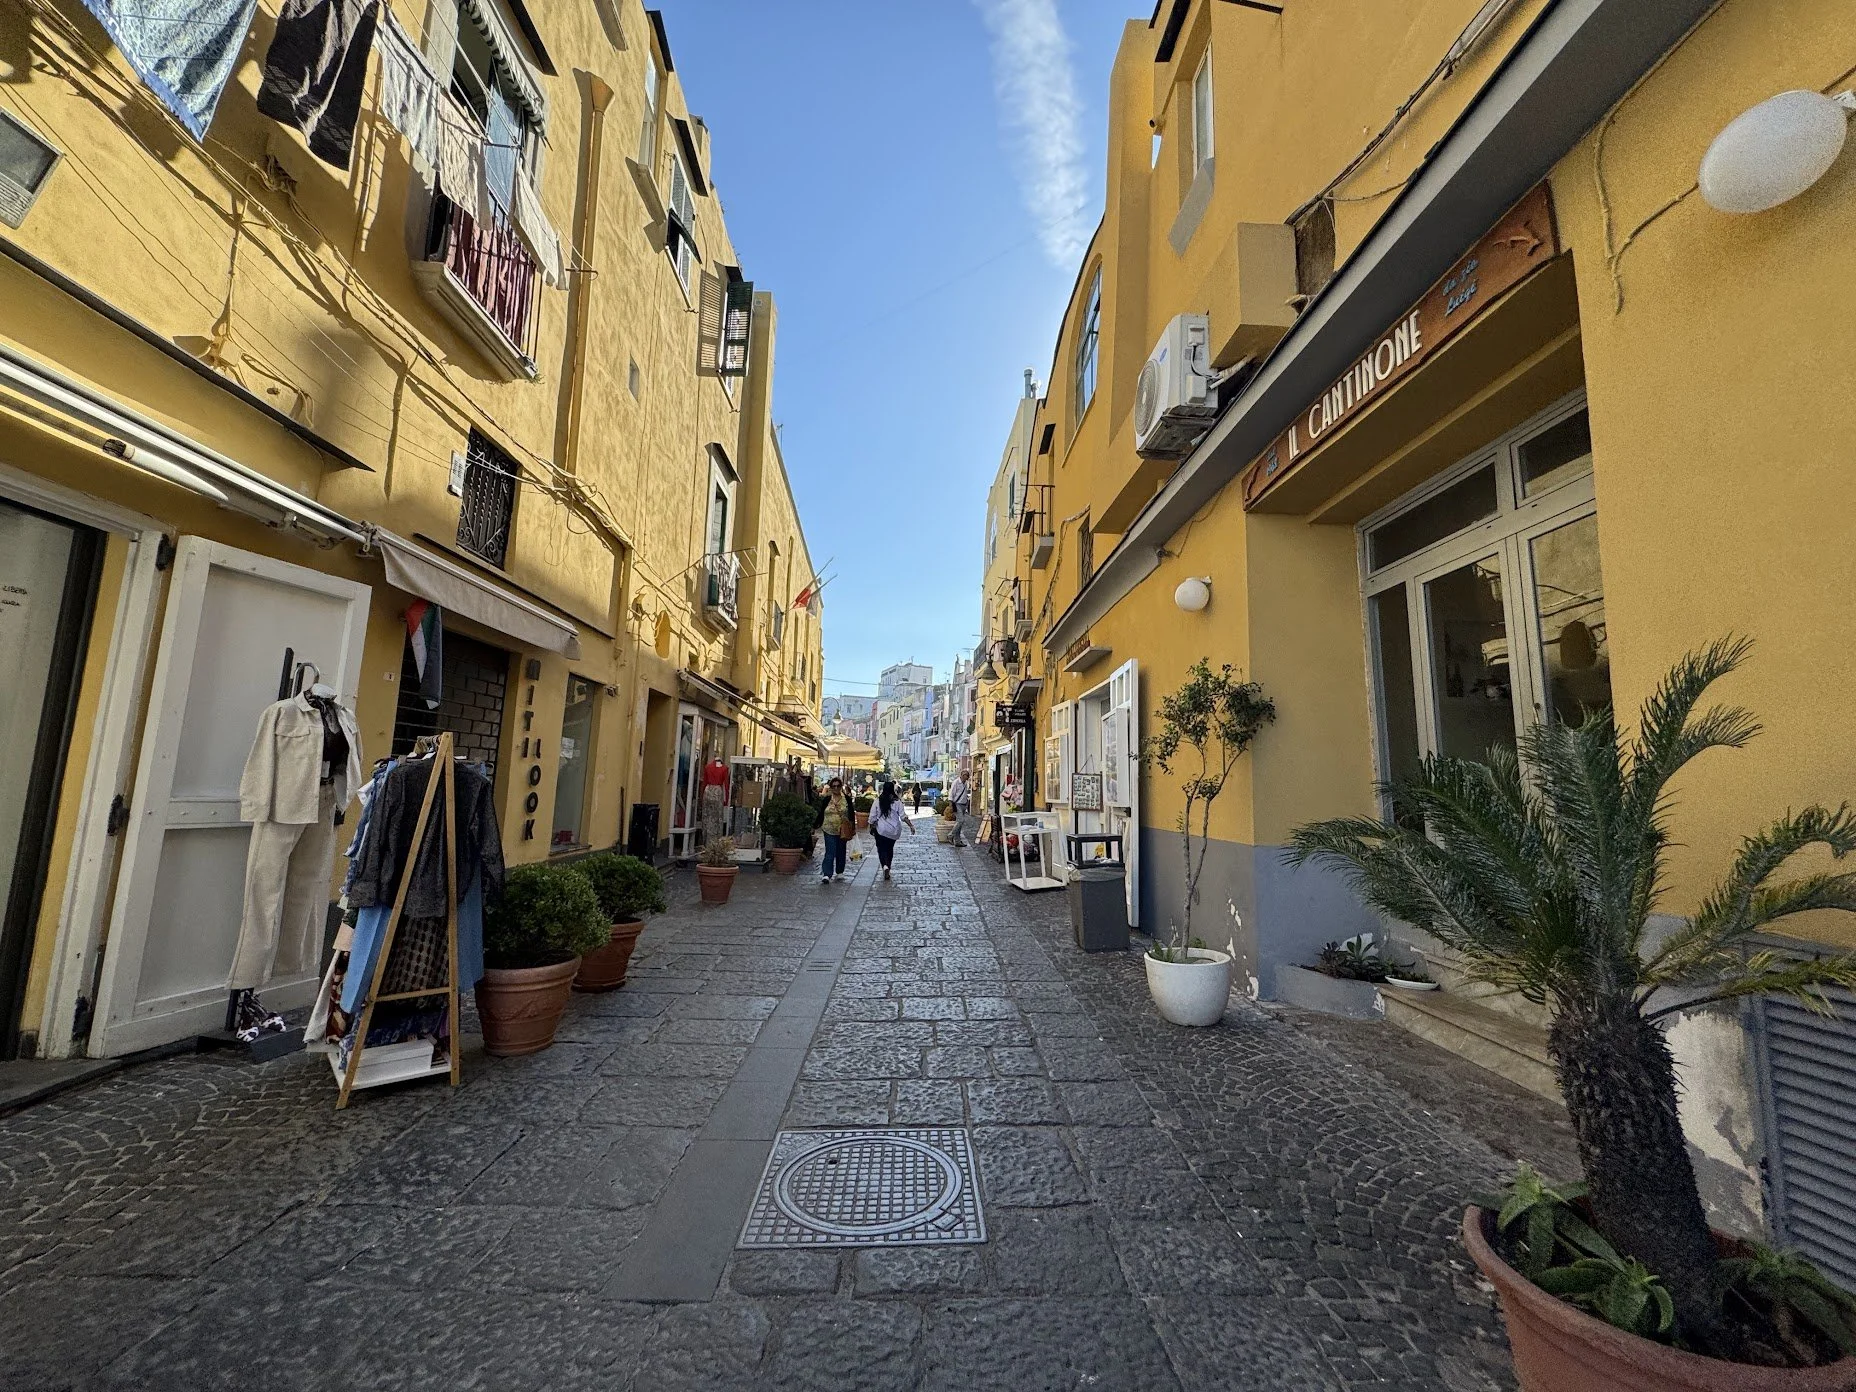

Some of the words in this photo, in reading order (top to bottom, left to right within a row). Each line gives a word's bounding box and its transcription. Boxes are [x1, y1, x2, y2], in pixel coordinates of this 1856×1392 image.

[1288, 426, 1300, 460] IL
[1308, 309, 1423, 440] CANTINONE
[523, 738, 541, 841] LOOK
